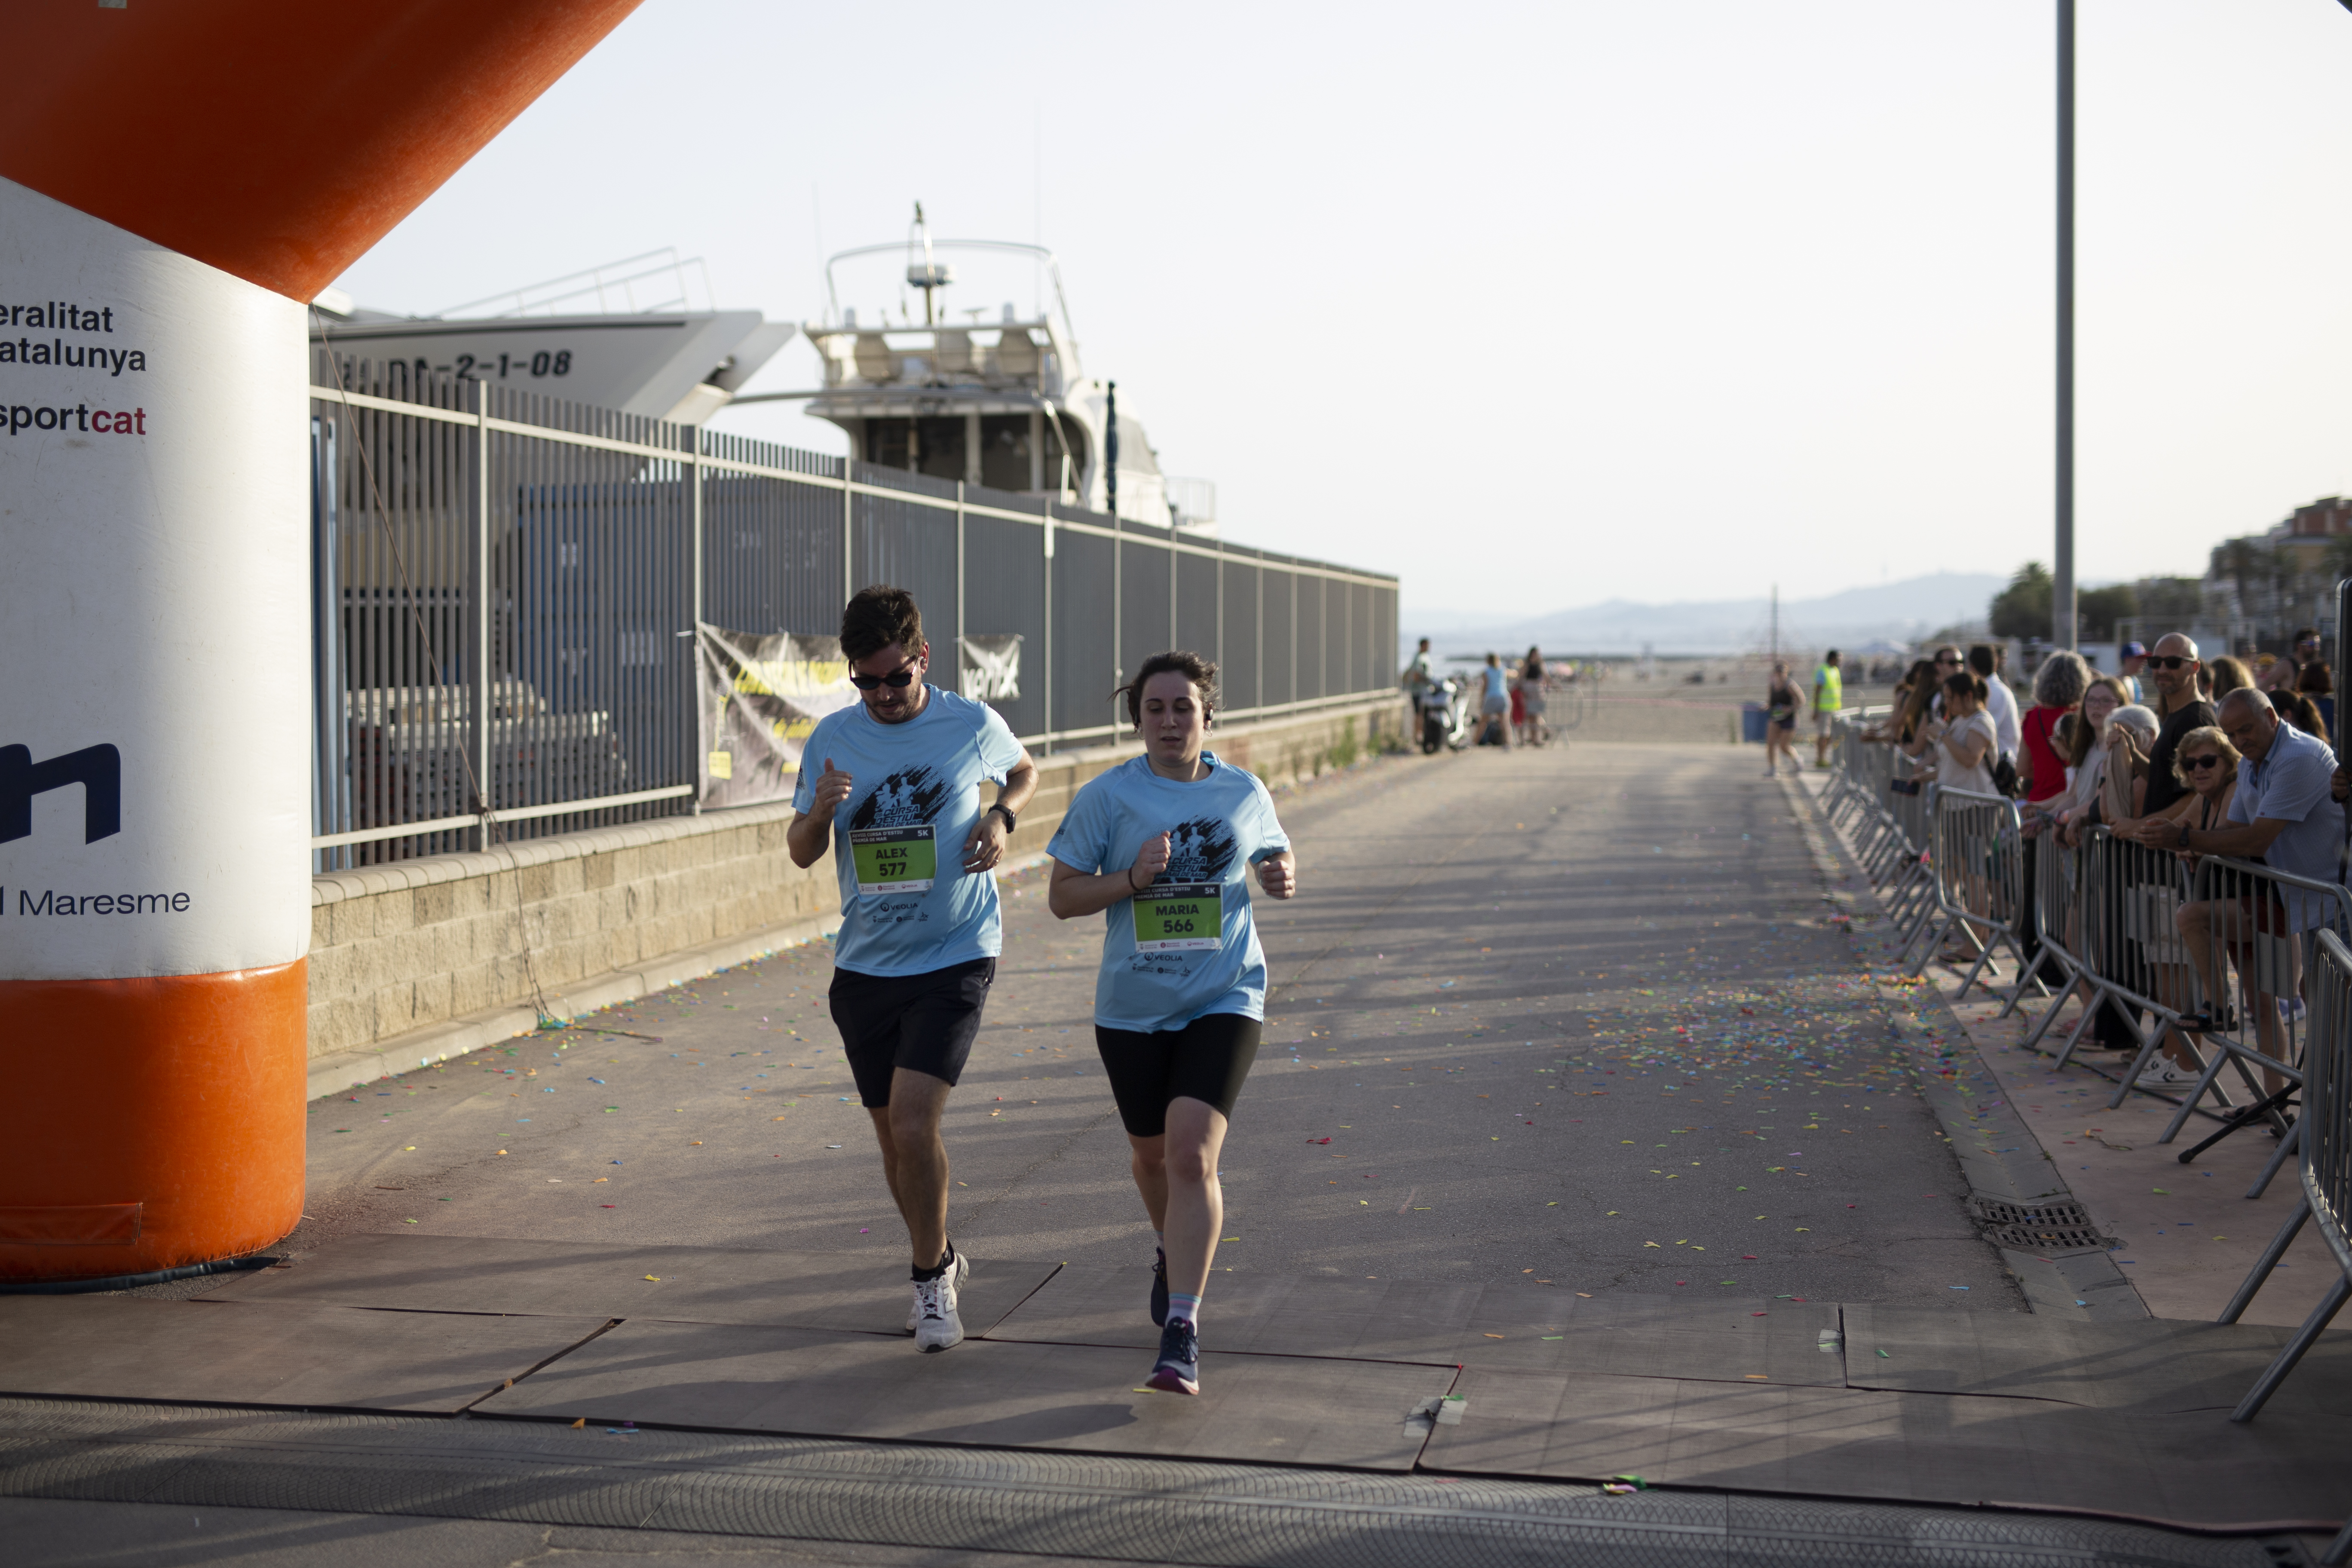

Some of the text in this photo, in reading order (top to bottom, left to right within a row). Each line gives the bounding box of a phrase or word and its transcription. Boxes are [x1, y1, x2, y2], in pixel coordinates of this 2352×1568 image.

[0, 337, 146, 377] atalunya
[883, 805, 919, 816] CURSA
[875, 847, 908, 860] ALEX
[1172, 857, 1206, 865] CURSA
[879, 862, 907, 876] 577
[20, 890, 190, 916] Maresme
[1156, 904, 1200, 916] MARIA
[1164, 919, 1194, 933] 566
